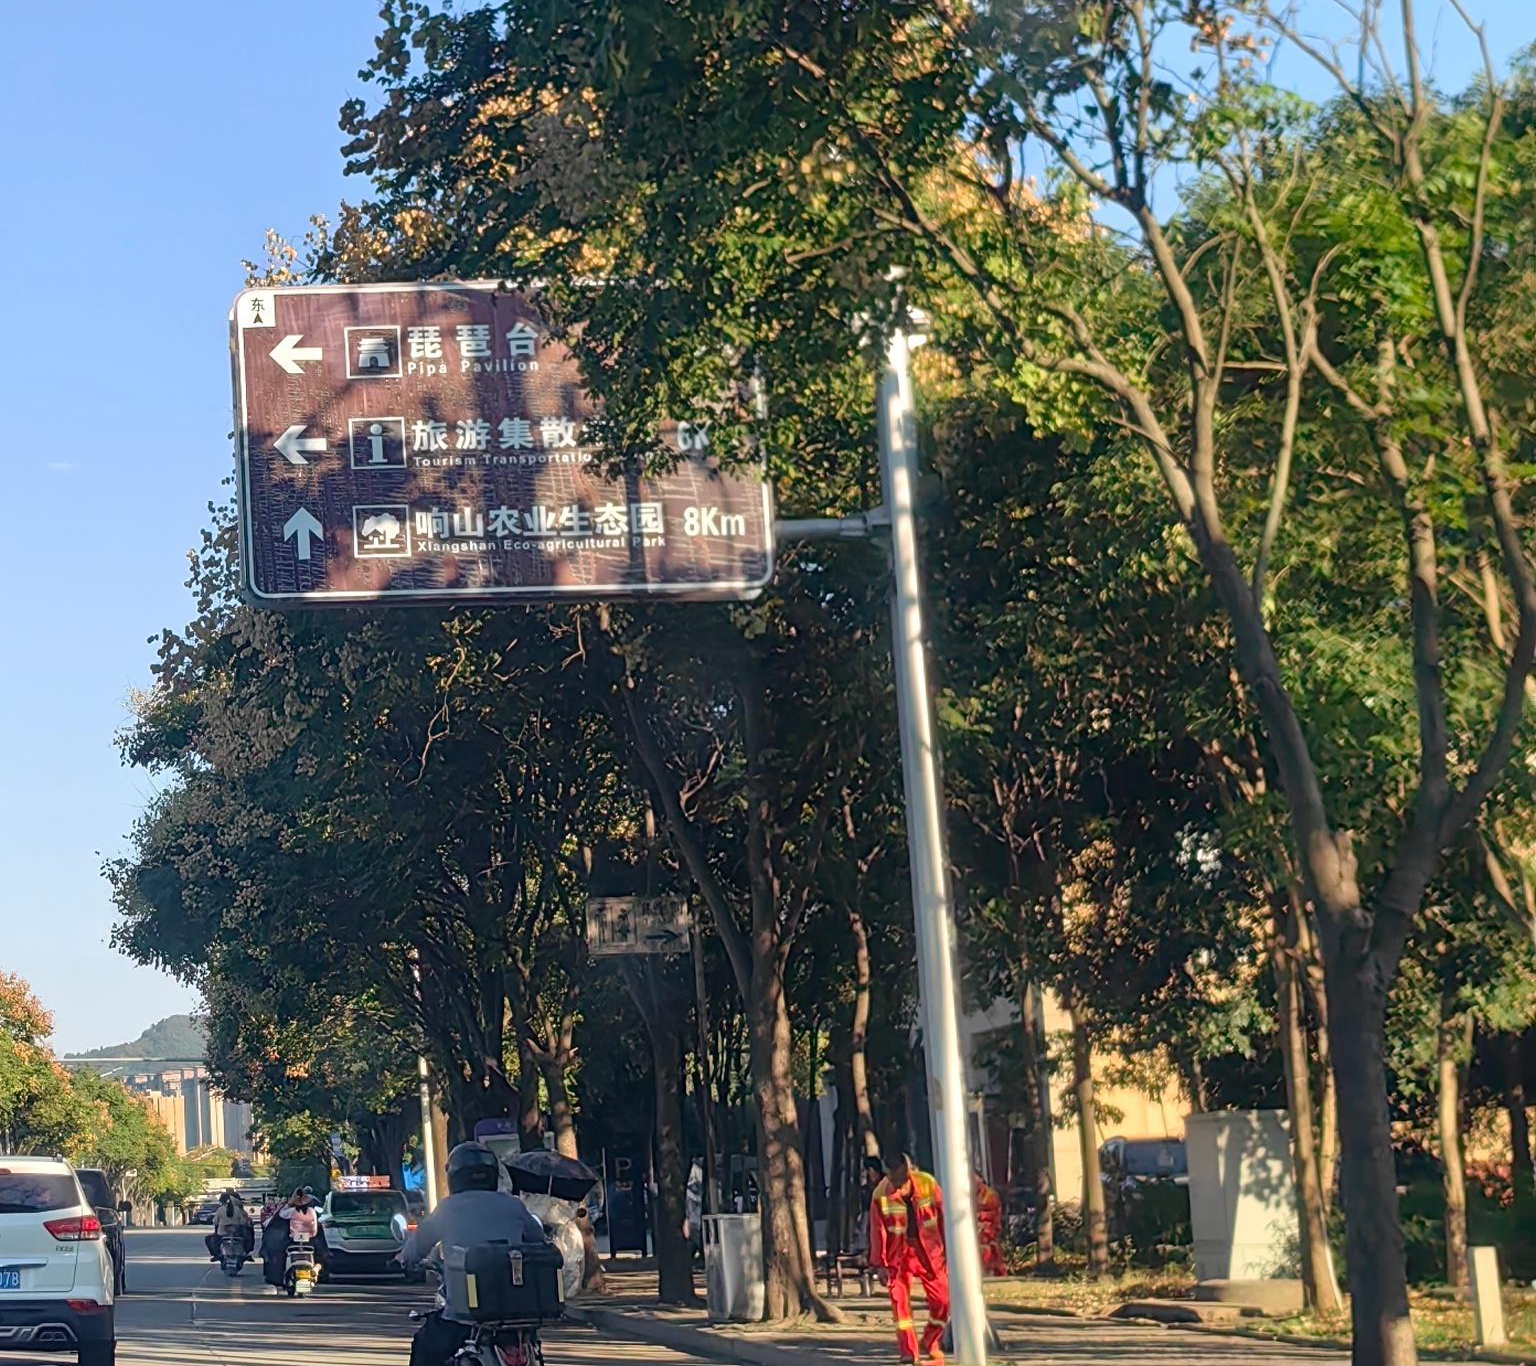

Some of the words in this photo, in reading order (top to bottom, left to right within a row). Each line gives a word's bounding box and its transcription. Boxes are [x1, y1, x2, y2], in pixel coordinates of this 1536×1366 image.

[251, 297, 265, 312] 东
[407, 321, 539, 359] 琵琶台
[461, 359, 539, 373] Pavilion
[411, 416, 607, 452] 旅游集散
[414, 456, 476, 467] Tourism
[482, 450, 593, 467] Transportatio
[415, 501, 664, 539] 响山农业生态园
[683, 506, 746, 537] 8Km
[417, 539, 496, 552] Xiangshan
[503, 536, 625, 552] Eco-agricultural
[632, 535, 666, 548] Park
